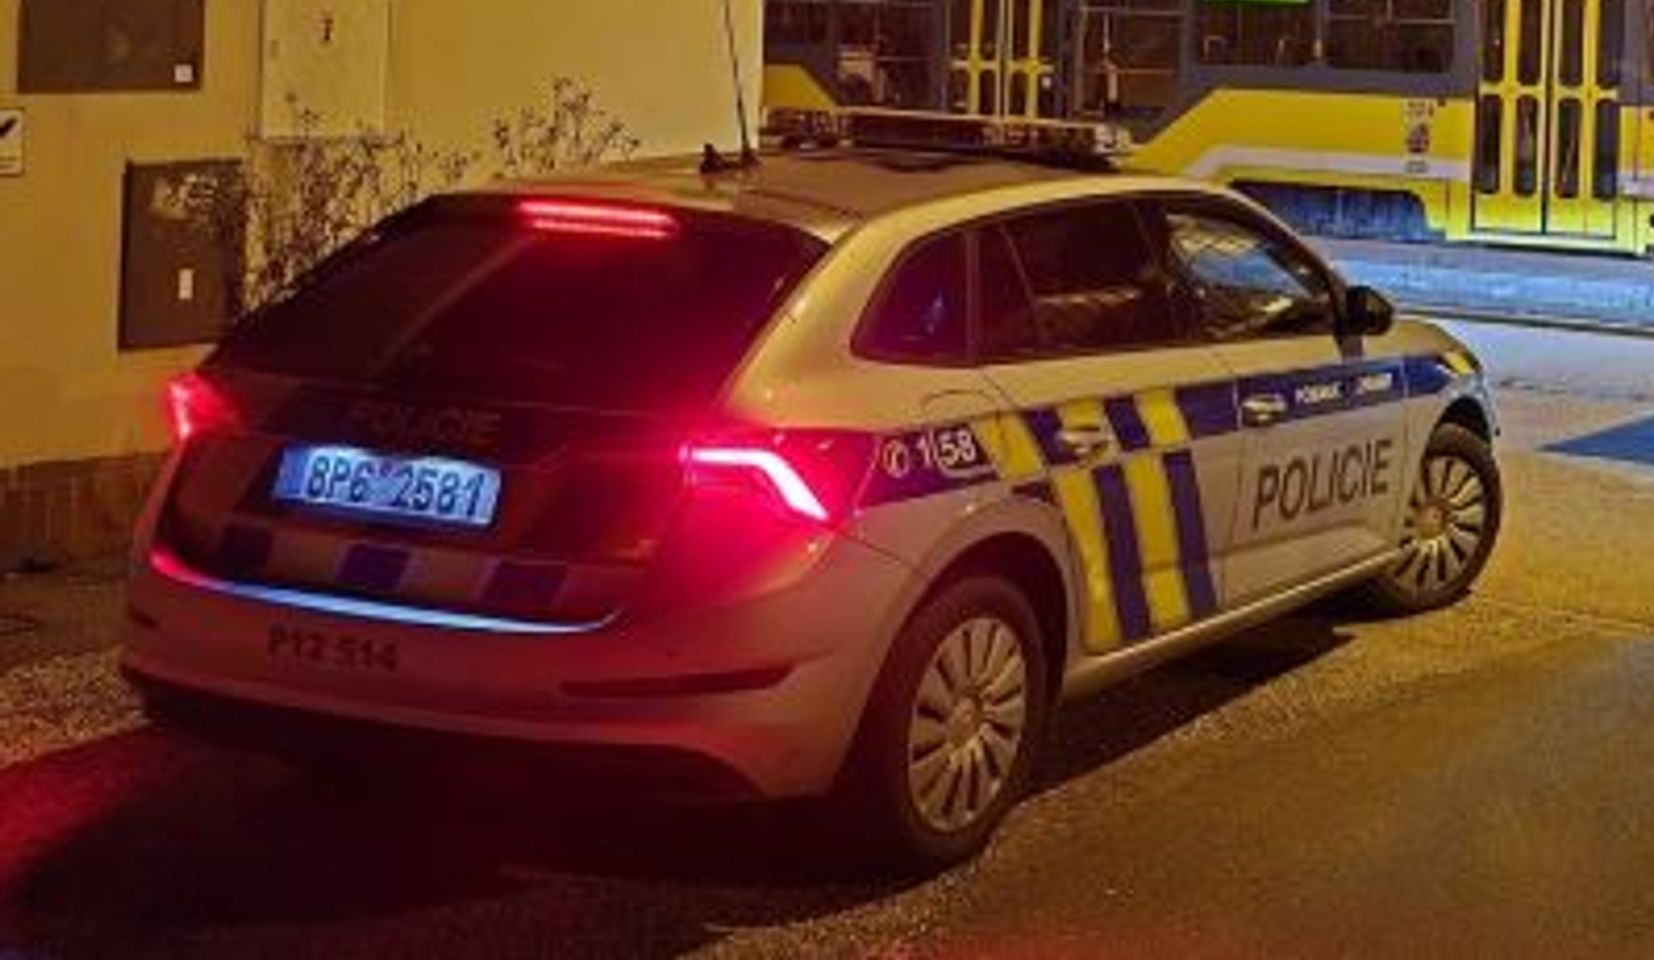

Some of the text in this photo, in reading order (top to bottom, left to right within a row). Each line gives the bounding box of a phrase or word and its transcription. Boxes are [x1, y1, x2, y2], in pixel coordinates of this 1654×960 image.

[307, 455, 485, 517] 8P6 2581
[1253, 439, 1393, 529] POLICIE
[267, 624, 324, 661] P12
